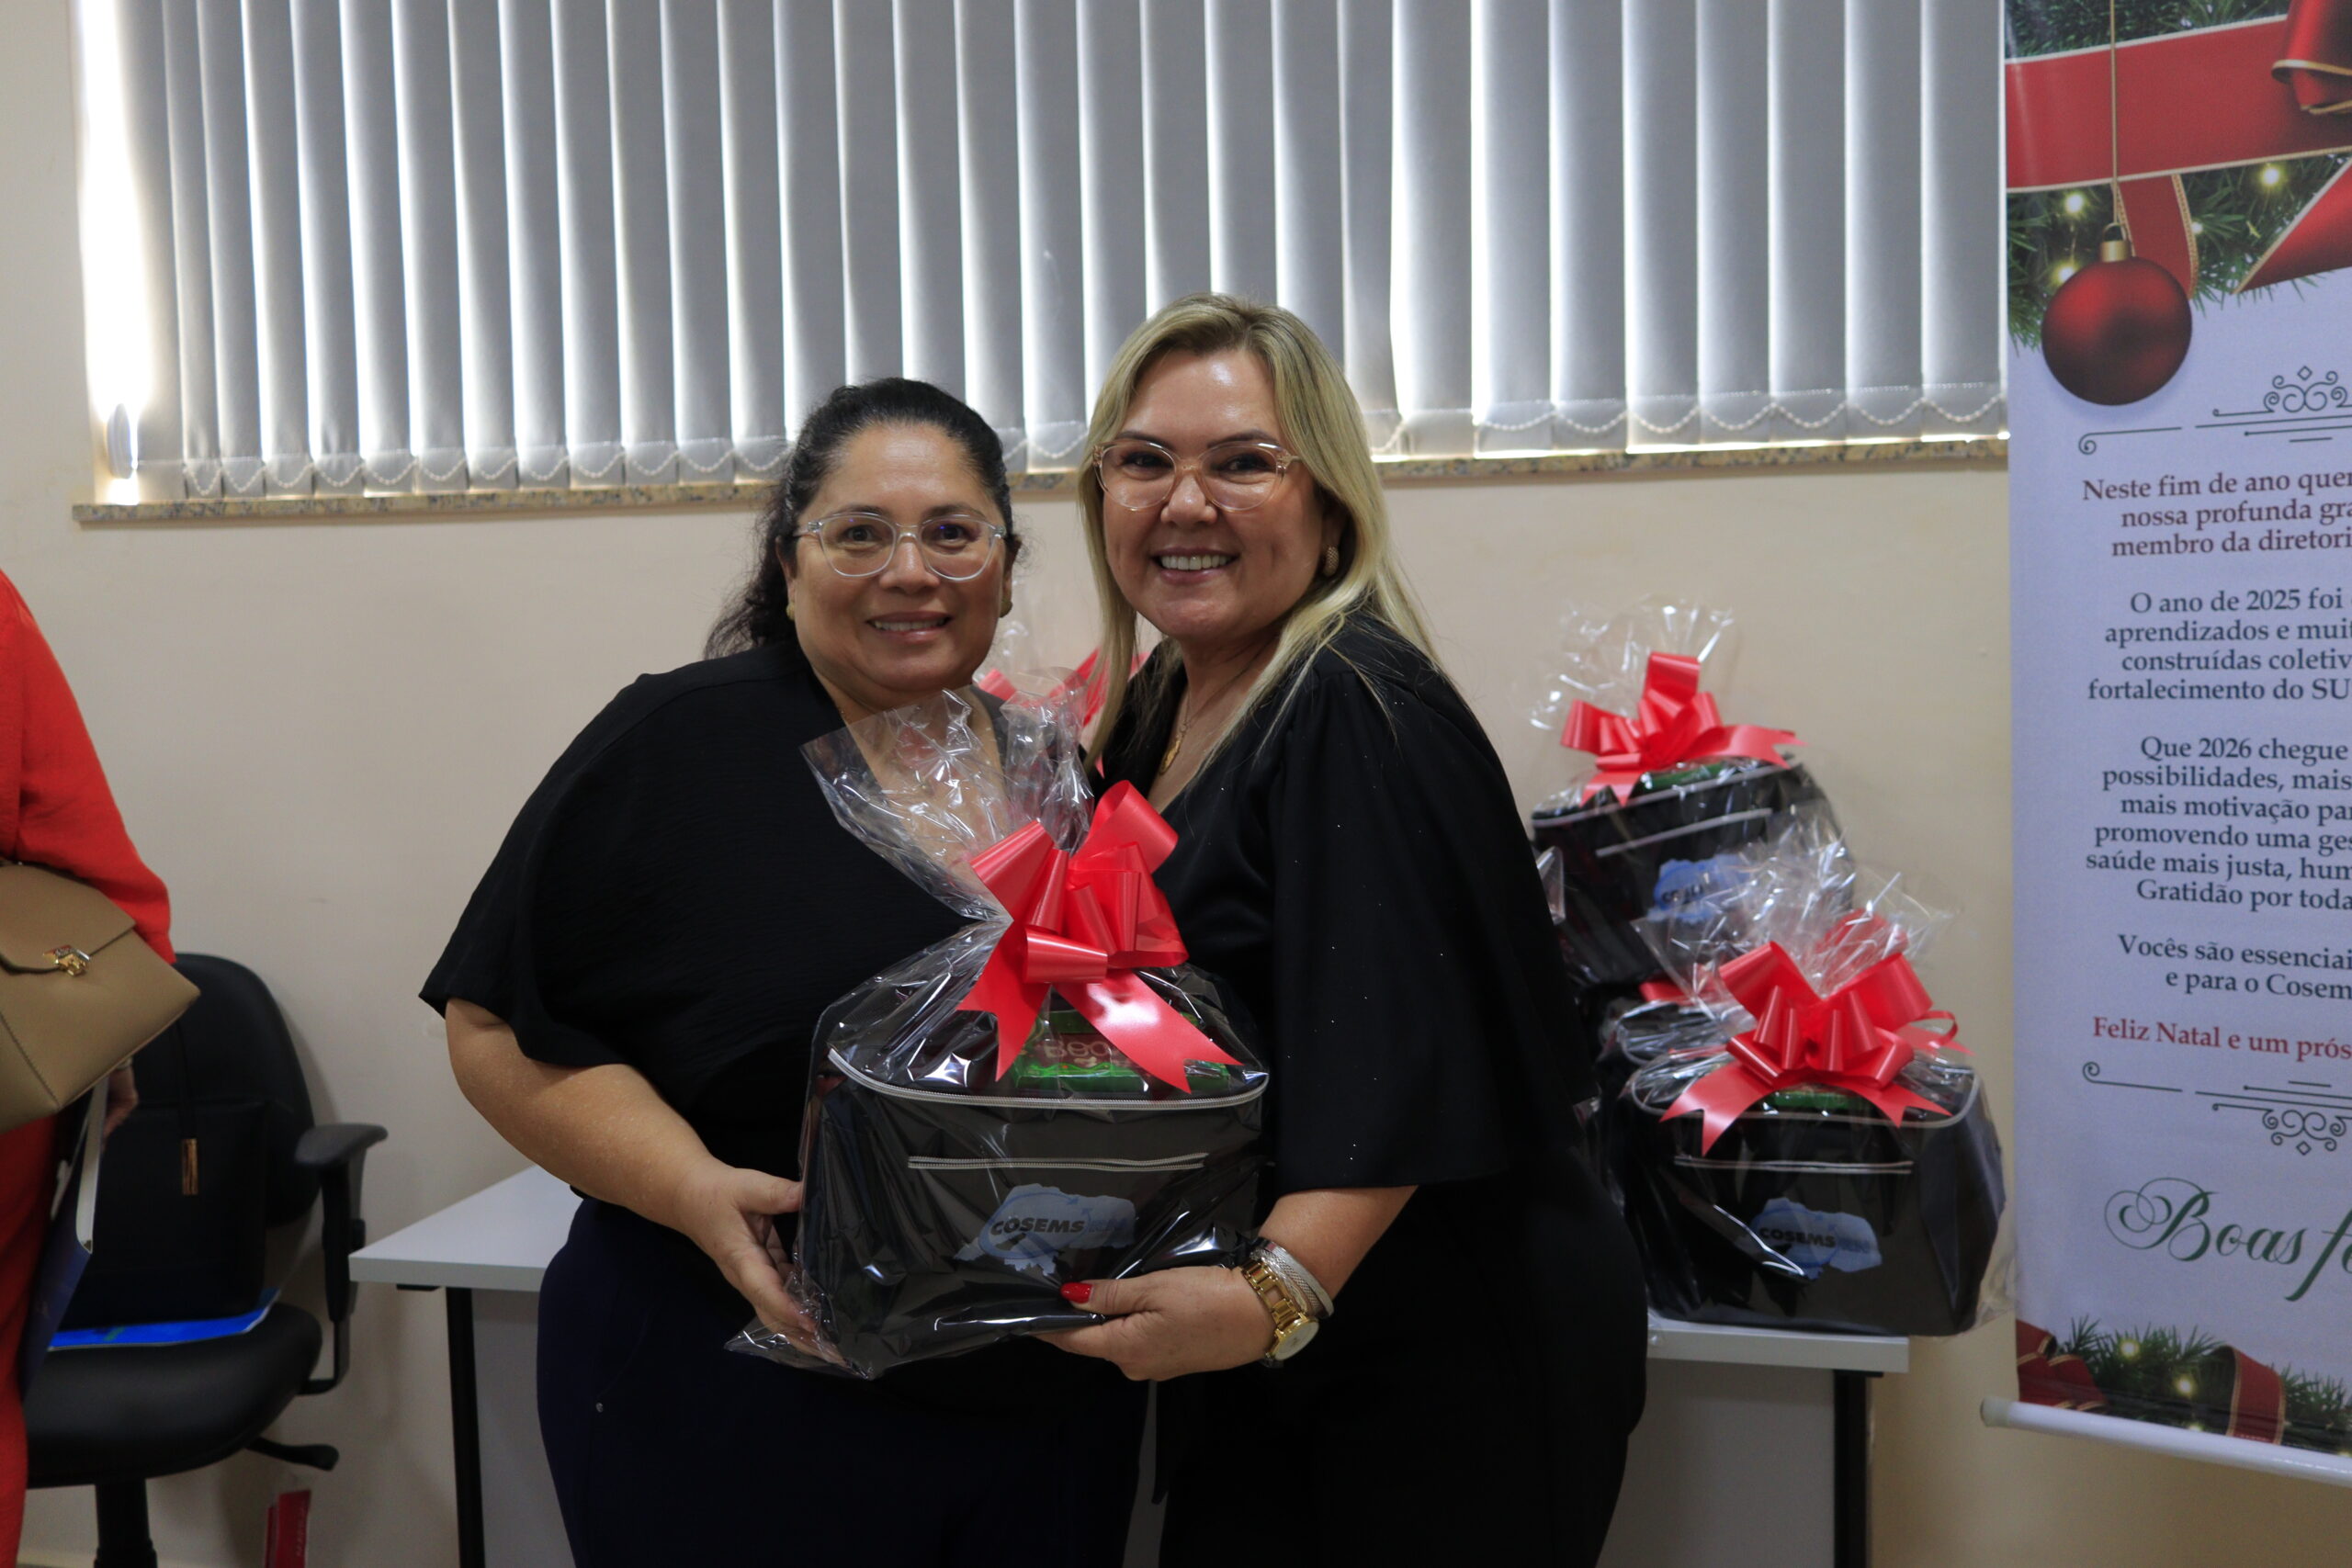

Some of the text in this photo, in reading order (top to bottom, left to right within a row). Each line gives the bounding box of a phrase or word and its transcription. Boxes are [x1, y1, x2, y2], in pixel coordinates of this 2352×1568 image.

[2083, 479, 2151, 500] Neste
[2159, 475, 2200, 496] fim
[2209, 472, 2237, 493] de
[2245, 475, 2290, 491] ano
[2122, 511, 2188, 527] nossa
[2196, 499, 2312, 531] profunda
[2112, 534, 2213, 556] membro
[2222, 531, 2250, 552] da
[2131, 592, 2152, 613] O
[2159, 597, 2203, 613] ano
[2211, 591, 2239, 611] de
[2246, 589, 2301, 610] 2025
[2309, 587, 2343, 609] foi
[2105, 619, 2269, 649] aprendizados
[2277, 626, 2290, 639] e
[2122, 649, 2352, 671] construídas coletiv
[2088, 678, 2265, 699] fortalecimento
[2273, 678, 2303, 699] do
[2141, 737, 2348, 766] Que 2026 chegue
[2103, 765, 2352, 792] possibilidades, mais
[2121, 795, 2177, 814] mais
[2185, 796, 2310, 823] motivação
[2095, 825, 2248, 847] promovendo
[2256, 833, 2311, 849] uma
[2086, 851, 2155, 871] saúde
[2164, 853, 2219, 874] mais
[2227, 854, 2291, 881] justa,
[2137, 879, 2243, 904] Gratidão
[2251, 891, 2292, 912] por
[2118, 934, 2352, 970] Vocês são essenciai
[2165, 972, 2352, 999] e para o Cosem
[2095, 1017, 2352, 1062] Feliz Natal e um prós
[990, 1217, 1085, 1235] COSEMS
[2105, 1177, 2308, 1265] Boas
[1759, 1227, 1836, 1248] COSEMS
